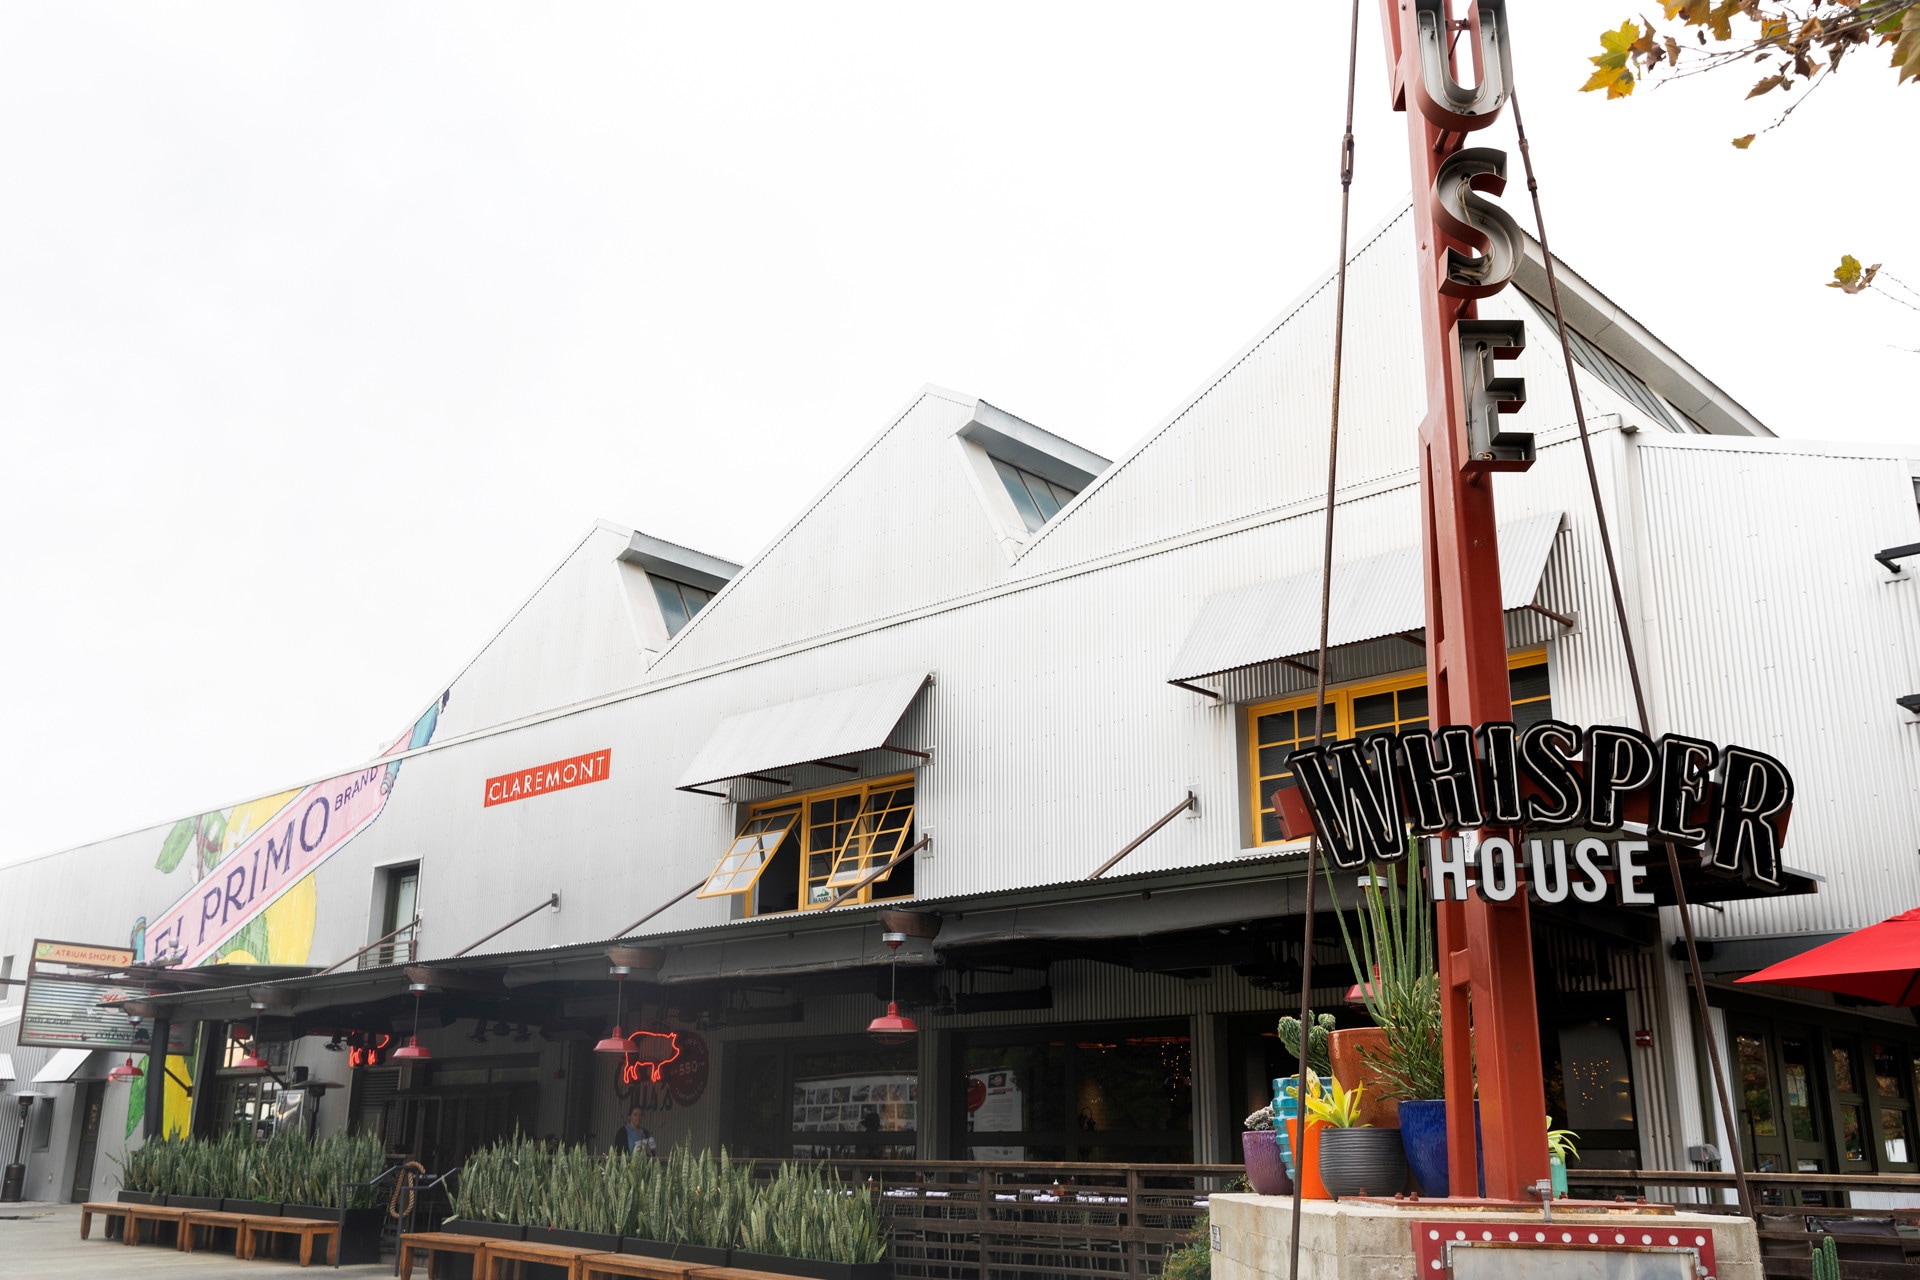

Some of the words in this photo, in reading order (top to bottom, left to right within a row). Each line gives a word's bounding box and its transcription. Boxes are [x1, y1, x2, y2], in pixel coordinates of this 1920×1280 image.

[1416, 0, 1535, 472] USE
[488, 756, 605, 801] CLAREMONT
[1284, 719, 1795, 892] WHISPER
[154, 915, 189, 961] EL
[197, 796, 330, 947] PRIMO
[334, 766, 378, 811] BRAND
[1424, 836, 1656, 905] HOUSE
[55, 949, 87, 959] ATRIUM
[89, 952, 117, 962] SHOPS
